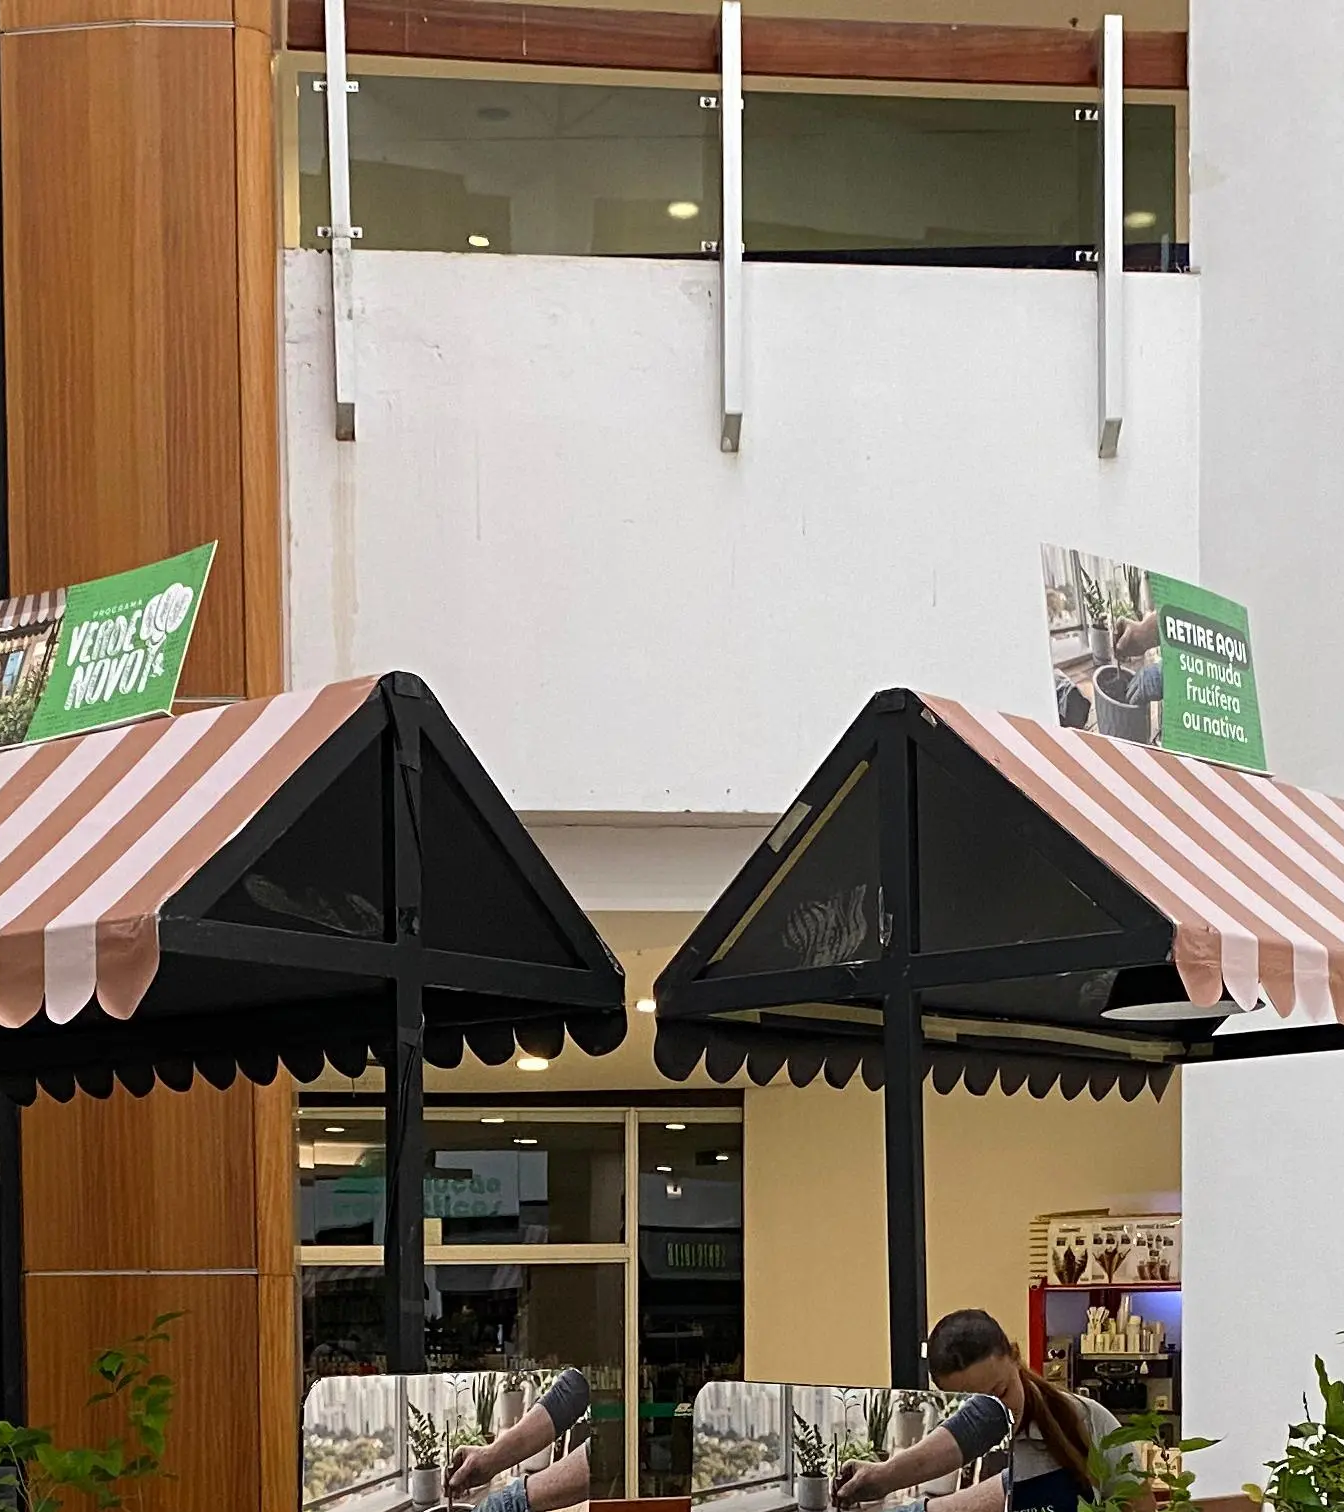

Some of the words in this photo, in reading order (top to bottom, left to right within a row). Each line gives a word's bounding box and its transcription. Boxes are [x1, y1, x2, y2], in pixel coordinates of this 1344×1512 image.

[67, 609, 142, 666] VERDE
[1166, 615, 1214, 651] RETIRE
[1215, 635, 1247, 664] AQUI
[64, 649, 144, 710] NOVO
[1179, 653, 1204, 676] sua
[1207, 659, 1241, 688] muda
[1186, 677, 1240, 714] frutífera
[1183, 712, 1201, 730] ou
[1203, 714, 1248, 743] nativa.
